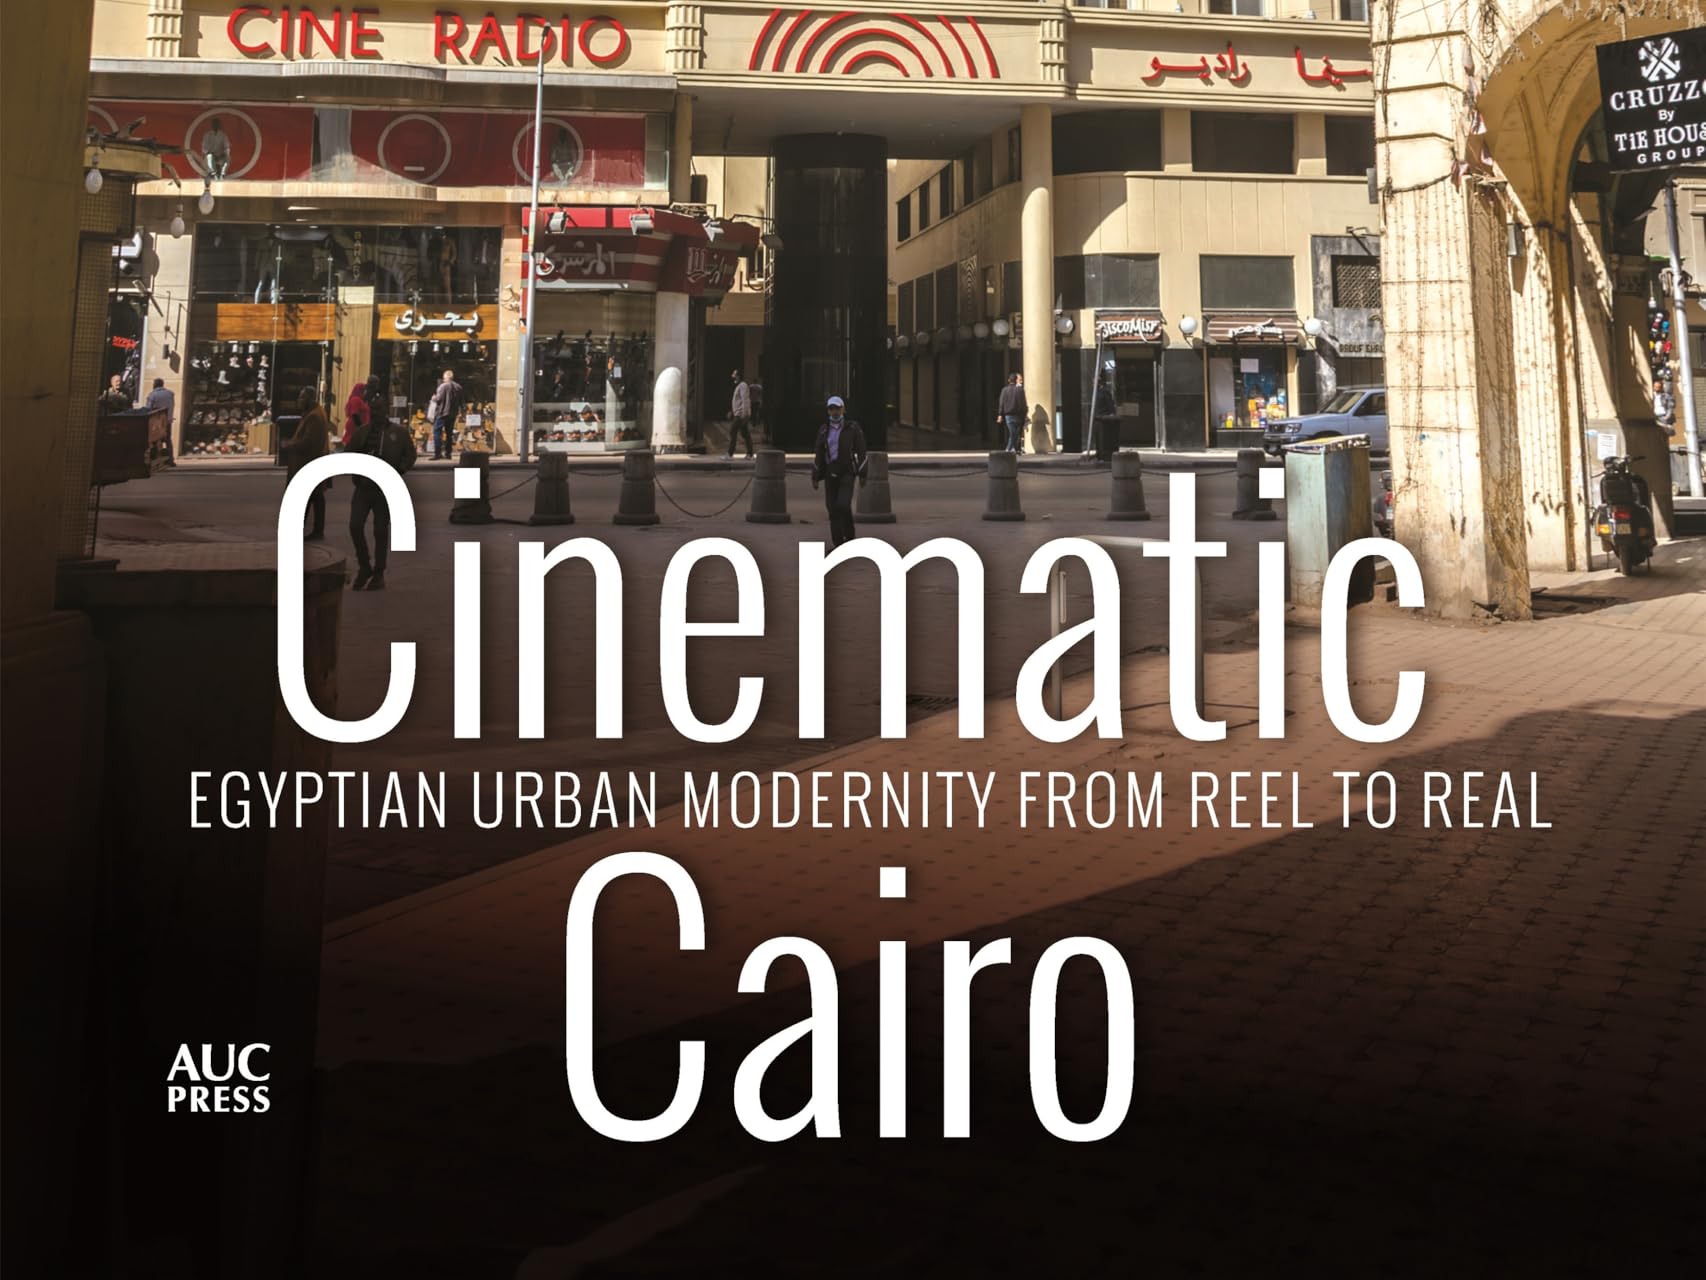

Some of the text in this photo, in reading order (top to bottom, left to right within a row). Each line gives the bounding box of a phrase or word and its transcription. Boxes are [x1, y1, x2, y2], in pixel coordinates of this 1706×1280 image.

[227, 6, 628, 63] CINE RADIO
[1141, 40, 1248, 81] راديو
[1610, 79, 1706, 111] CRUZZ
[1658, 108, 1675, 122] By
[1637, 145, 1705, 164] GROUP
